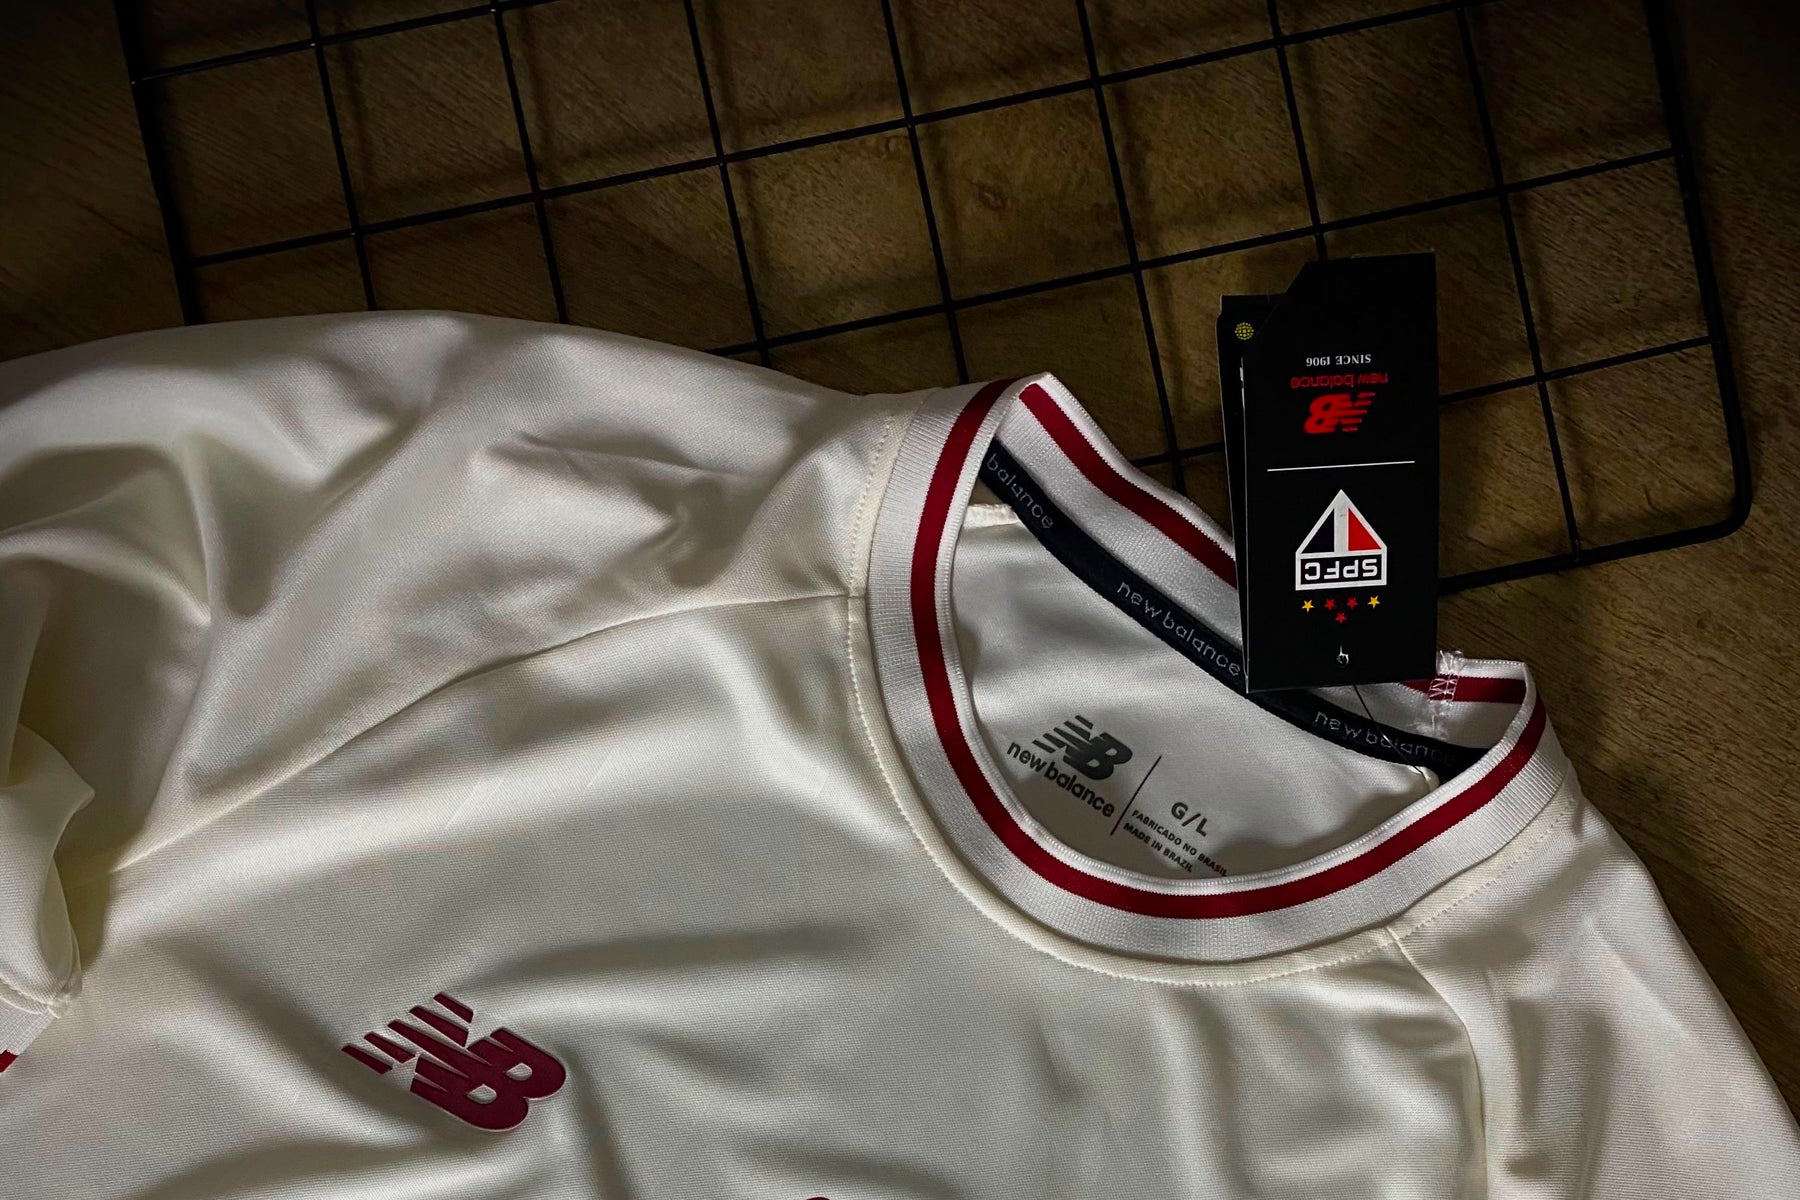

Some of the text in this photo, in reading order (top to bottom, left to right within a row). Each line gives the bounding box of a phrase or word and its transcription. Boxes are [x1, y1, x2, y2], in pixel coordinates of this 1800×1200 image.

[1290, 372, 1388, 389] new balance
[1306, 354, 1372, 367] SINCE 1906
[985, 453, 1054, 529] balance
[1304, 557, 1379, 582] SPFC
[1116, 581, 1241, 677] new balance
[1313, 711, 1362, 738] new
[1006, 741, 1116, 818] new balance
[1171, 802, 1208, 837] G/L
[1123, 823, 1193, 873] MADE IN BRAZIL
[1132, 810, 1228, 877] FABRICADO NO BRASIL
